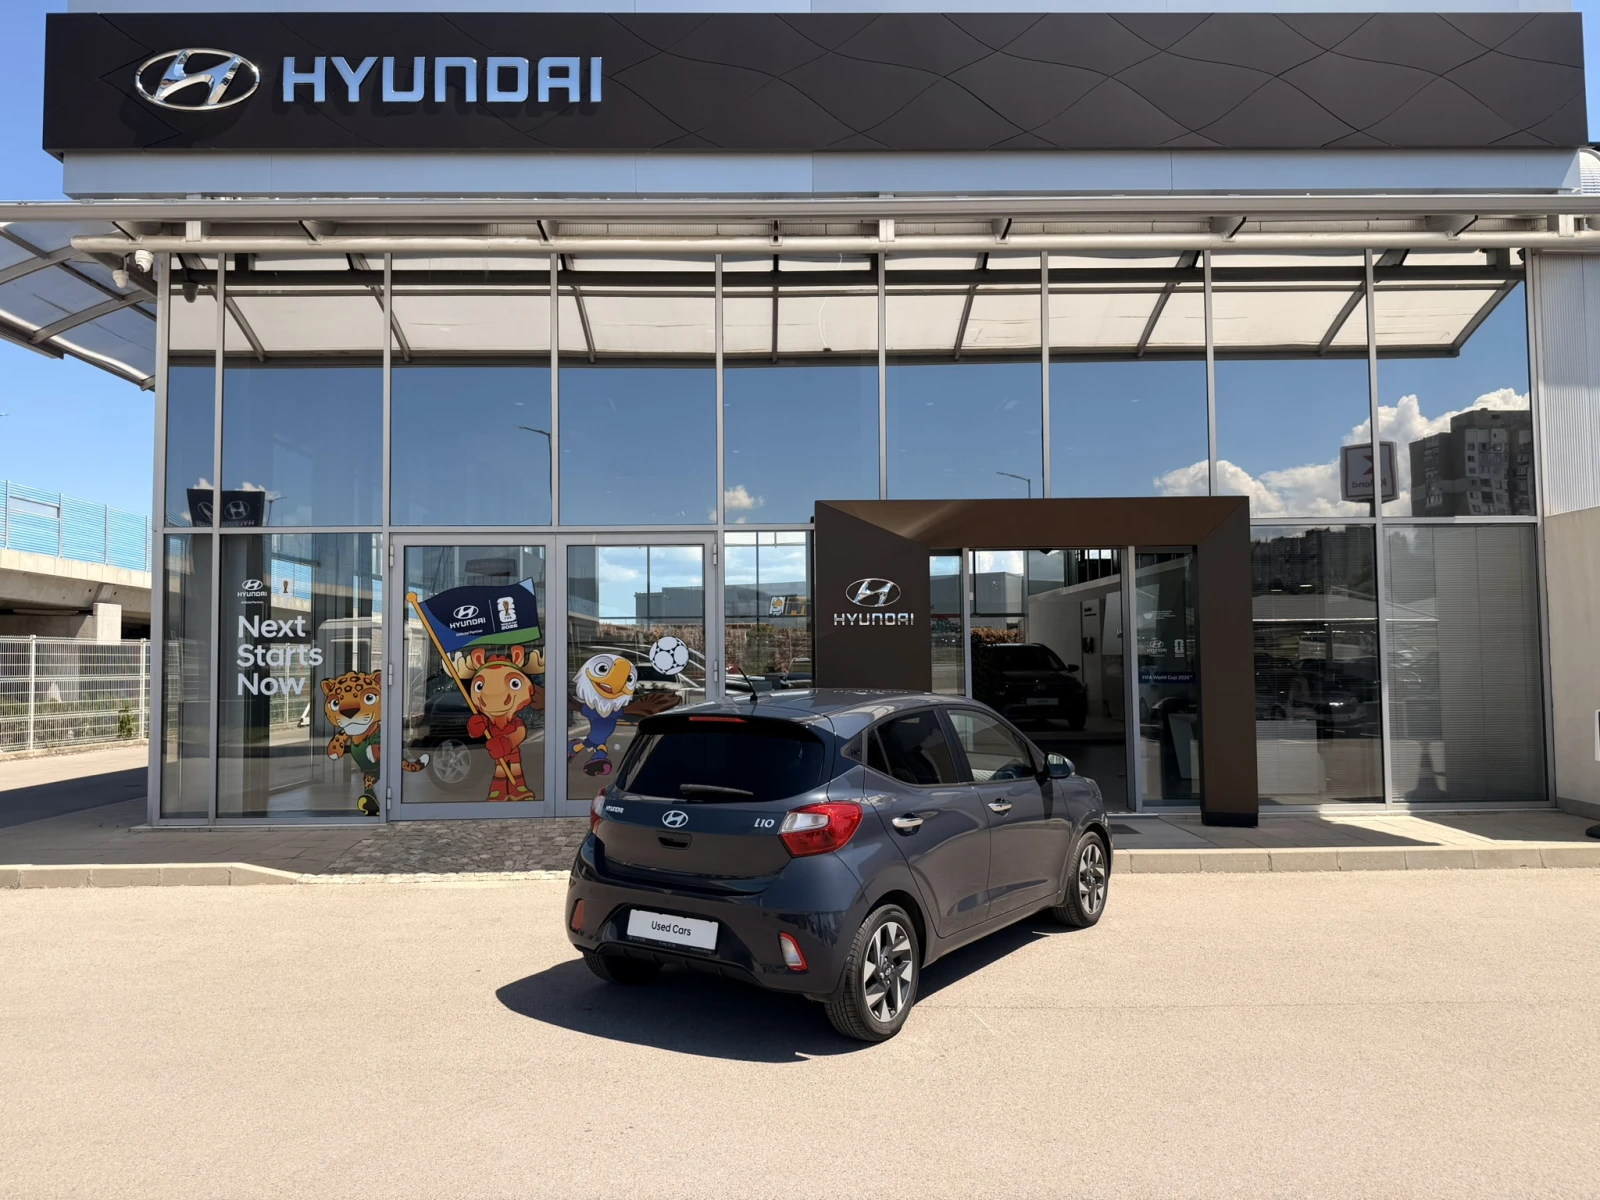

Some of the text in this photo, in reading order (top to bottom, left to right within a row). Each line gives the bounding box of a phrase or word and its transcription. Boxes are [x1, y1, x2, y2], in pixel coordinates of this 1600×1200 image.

[283, 56, 602, 103] HYUNDAI
[238, 615, 306, 638] Next
[450, 617, 486, 629] HYUNDAI
[834, 613, 914, 626] HYUNDAI
[236, 643, 324, 667] Starts
[238, 672, 306, 696] Now
[651, 920, 691, 936] Used Cars
